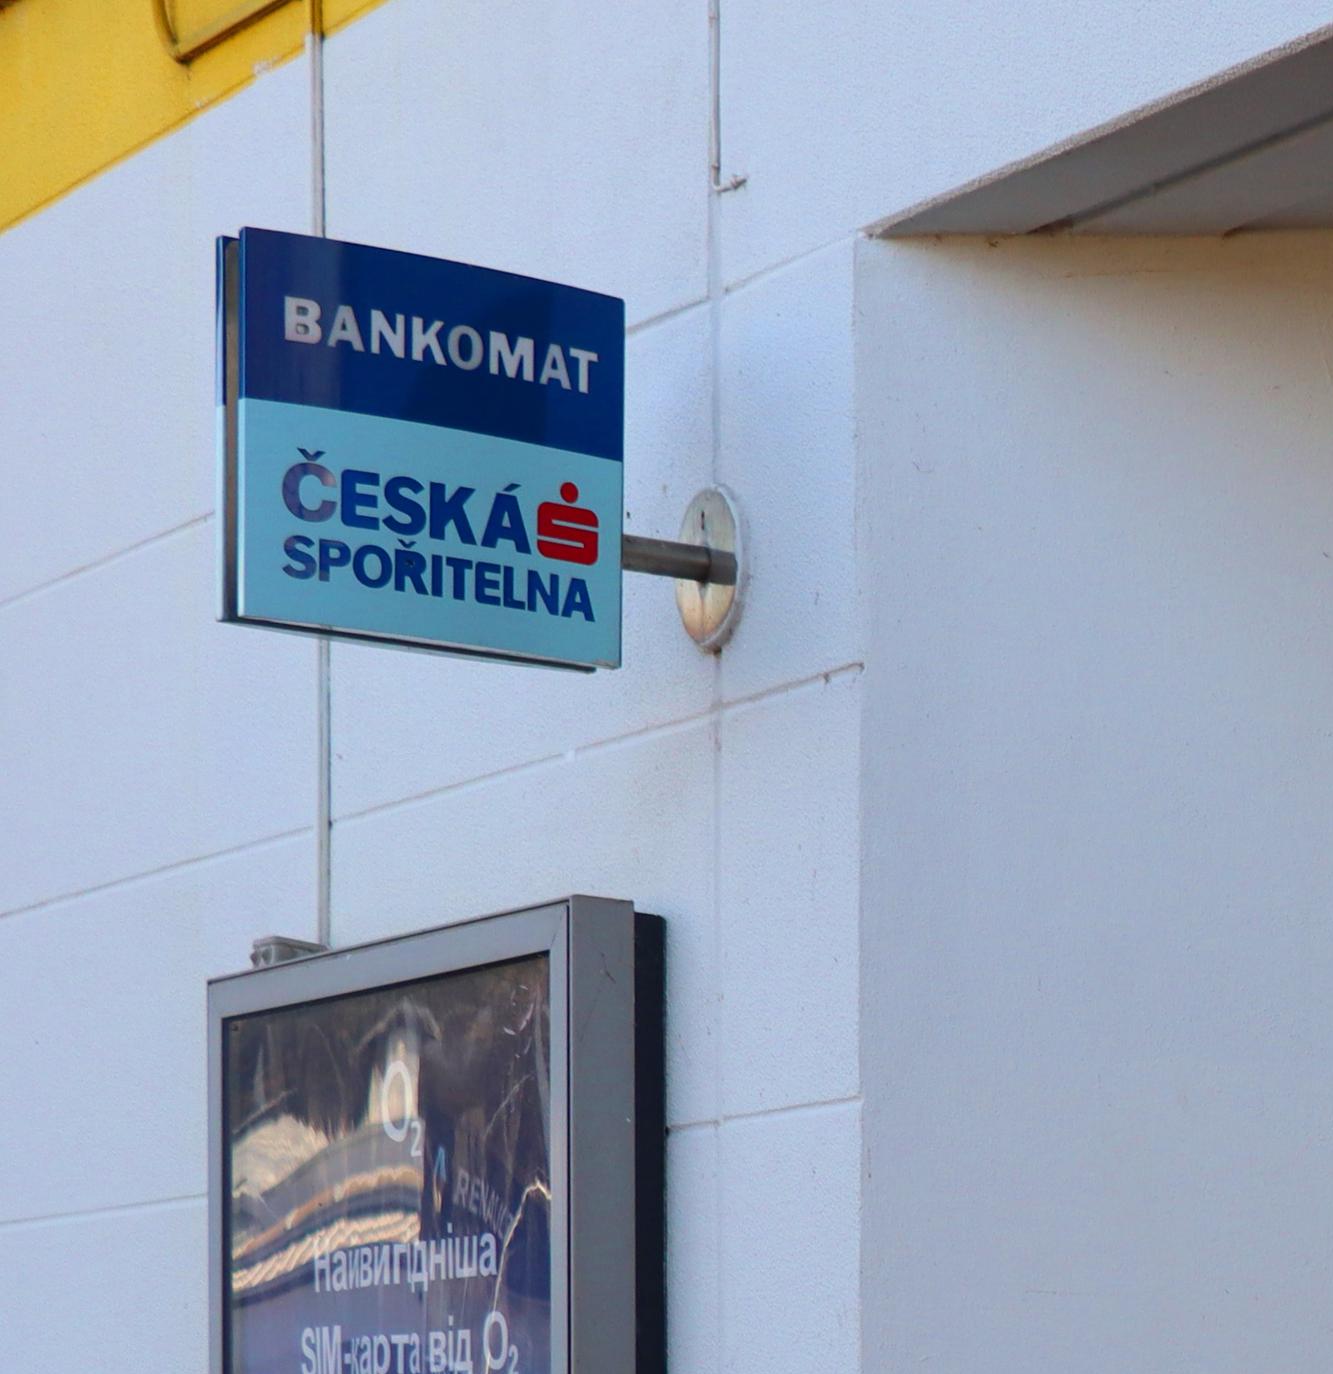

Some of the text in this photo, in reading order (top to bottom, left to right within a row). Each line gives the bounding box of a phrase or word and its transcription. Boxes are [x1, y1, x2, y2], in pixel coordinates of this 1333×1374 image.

[284, 296, 598, 394] BANKOMAT
[282, 448, 531, 555] ČESKÁ
[282, 535, 595, 622] SPOŘITELNA
[381, 1060, 422, 1157] O2
